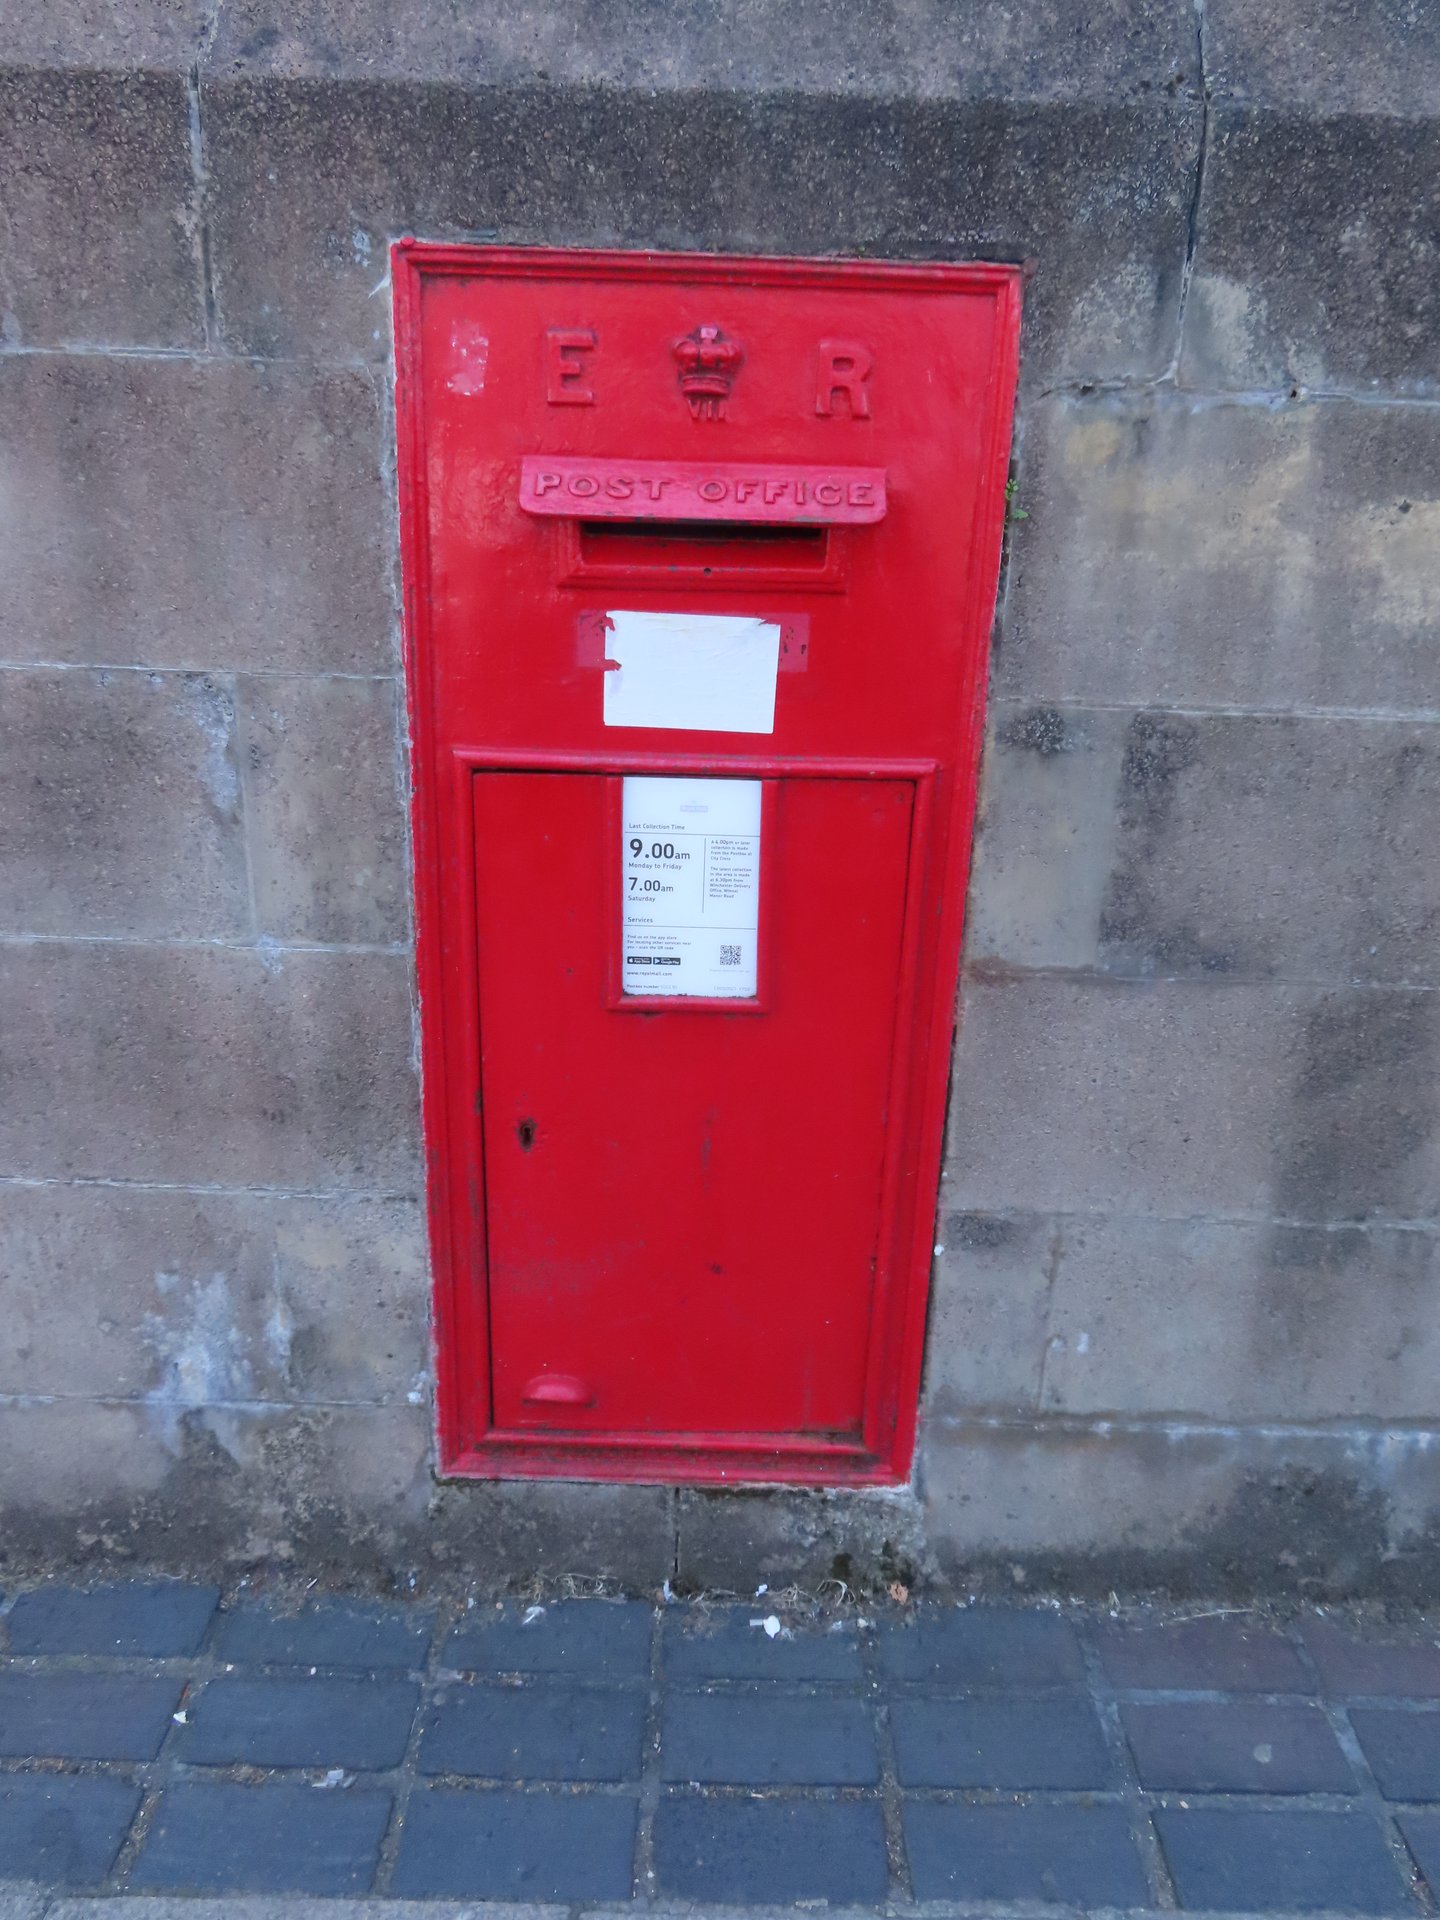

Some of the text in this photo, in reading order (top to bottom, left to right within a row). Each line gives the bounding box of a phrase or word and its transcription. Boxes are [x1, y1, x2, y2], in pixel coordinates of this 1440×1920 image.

[546, 328, 876, 419] E R
[688, 399, 726, 418] VII
[534, 472, 875, 507] POST OFFICE
[630, 838, 690, 860] 9.00am
[628, 877, 674, 892] 7.00am
